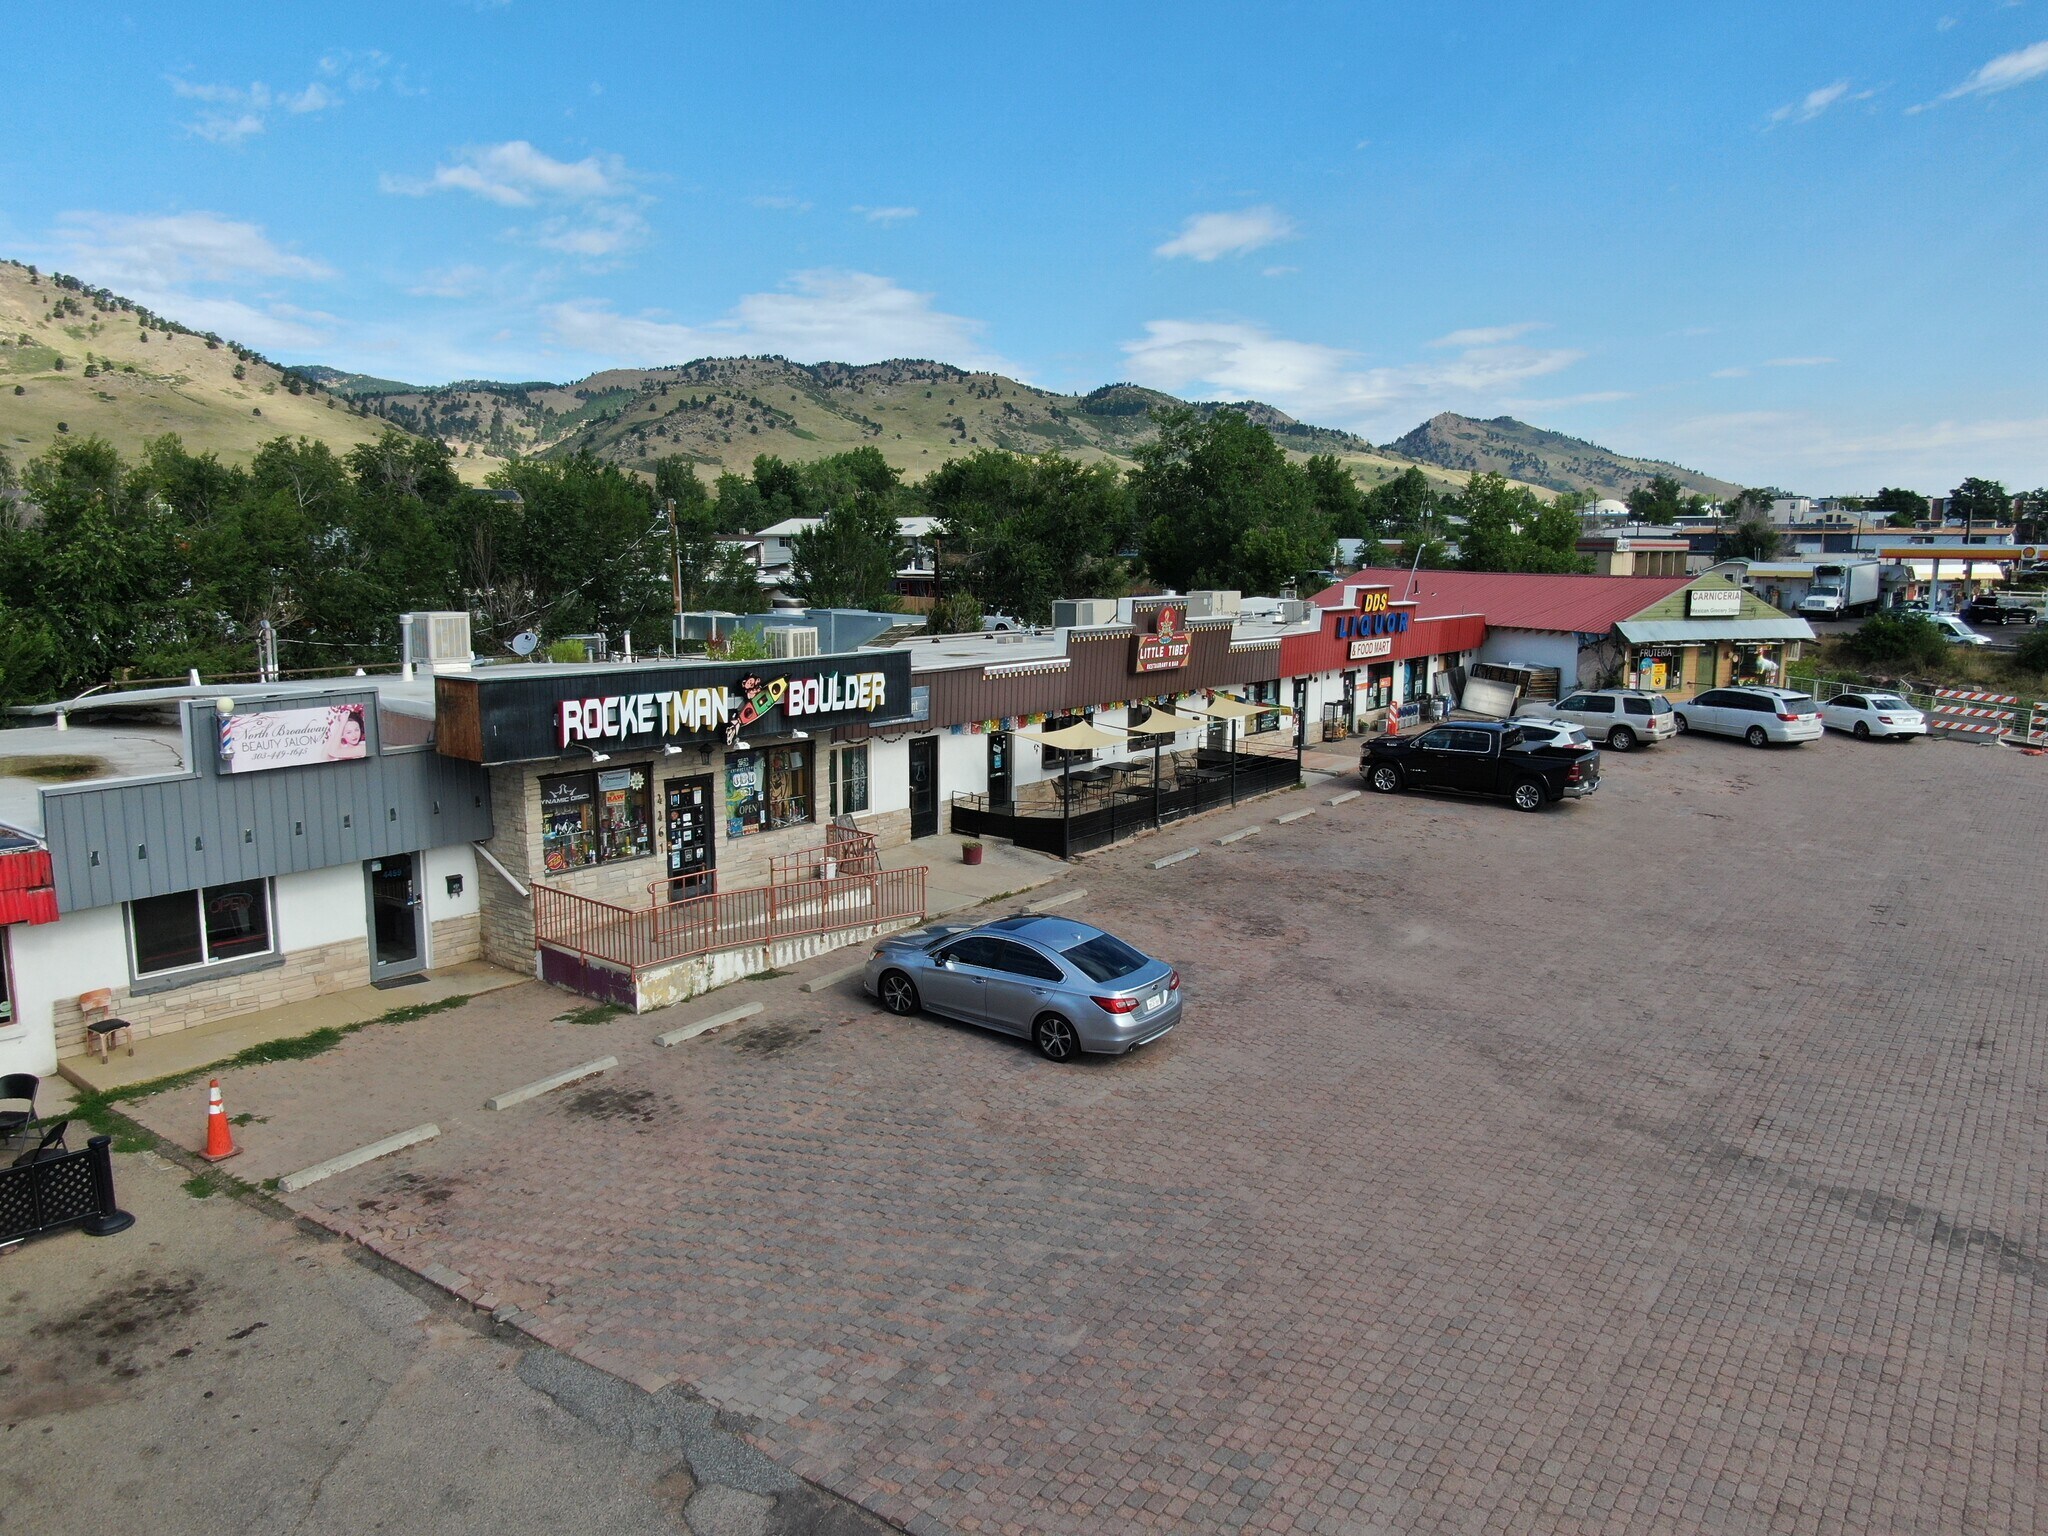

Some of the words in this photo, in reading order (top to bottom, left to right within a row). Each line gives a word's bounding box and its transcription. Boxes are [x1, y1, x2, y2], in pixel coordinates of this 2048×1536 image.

[1364, 593, 1388, 612] DDS
[1692, 592, 1740, 601] CARNICERIA
[1337, 612, 1409, 638] LIQUOR
[1139, 646, 1165, 660] LITTLE
[1168, 643, 1189, 656] TIBET
[1351, 644, 1356, 656] &
[1357, 642, 1373, 655] FOOD
[1374, 640, 1390, 653] MART
[1640, 648, 1672, 657] FRUTERIA
[1146, 662, 1168, 670] RESTAURANT
[560, 686, 728, 748] ROCKETMAN
[786, 671, 886, 716] BOULDER
[235, 721, 269, 742] North
[272, 719, 328, 741] Broadway
[242, 738, 281, 752] BEAUTY
[284, 736, 317, 748] SALON
[252, 748, 308, 760] 303-449-1645
[541, 796, 570, 804] YNAMIC
[607, 794, 625, 802] RAW
[739, 803, 758, 815] OPEN
[209, 895, 250, 914] OPEN
